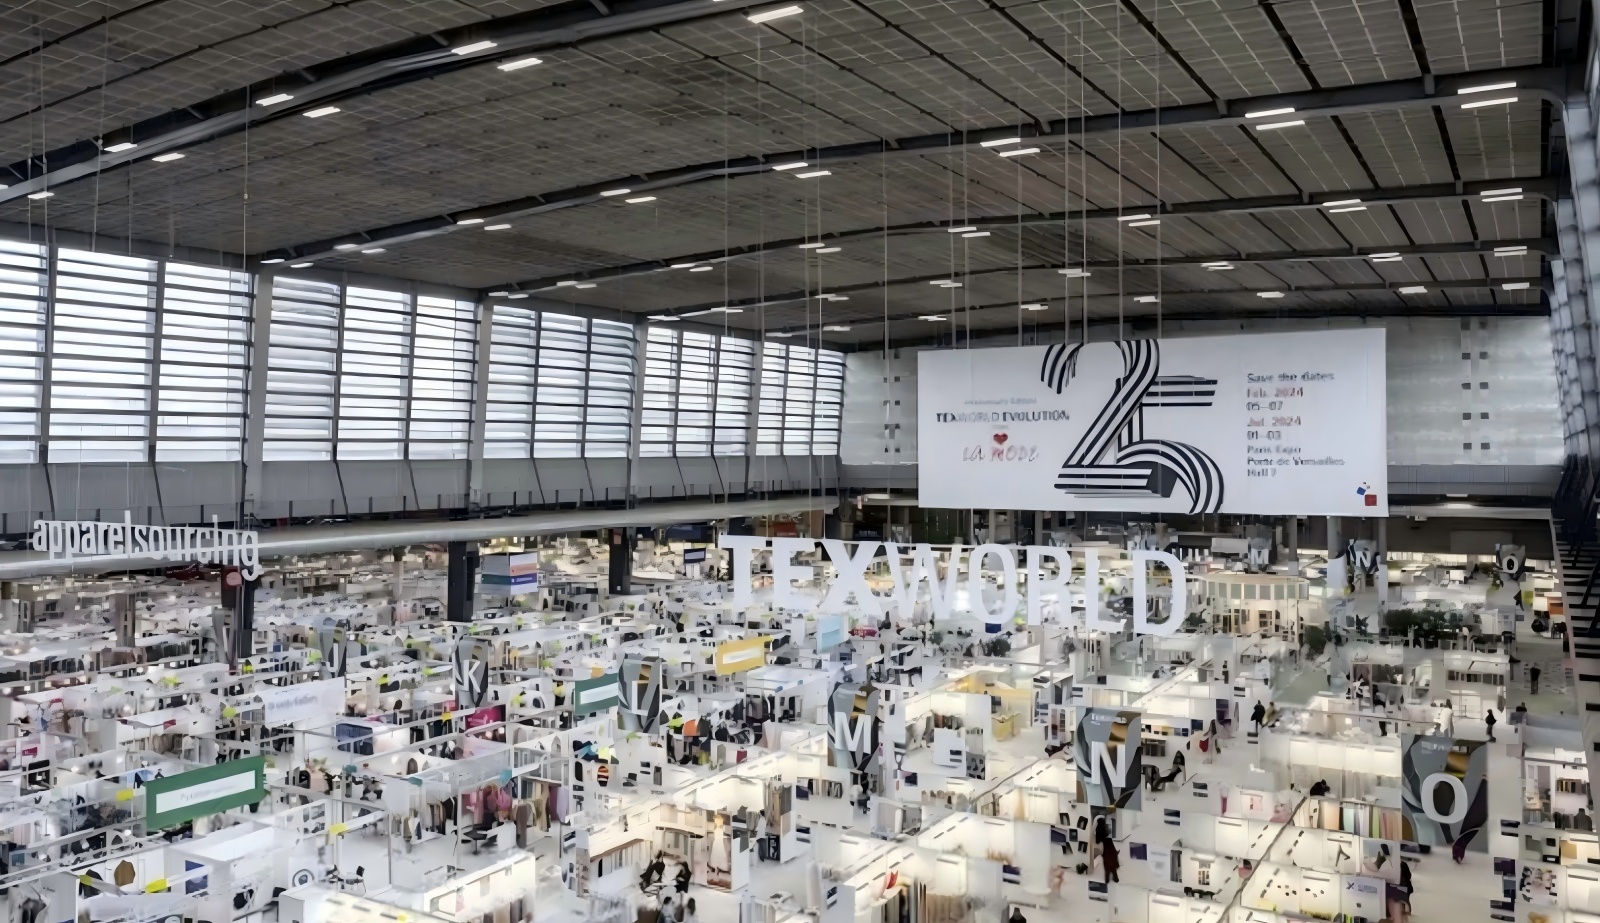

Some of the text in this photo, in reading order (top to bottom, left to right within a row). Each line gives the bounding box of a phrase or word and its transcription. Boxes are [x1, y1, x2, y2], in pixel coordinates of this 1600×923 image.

[33, 510, 261, 581] apparelsourcing
[718, 535, 1187, 636] TEXWORLD
[463, 659, 482, 692] K
[834, 711, 872, 755] M
[1091, 740, 1126, 788] N
[1421, 772, 1469, 824] O
